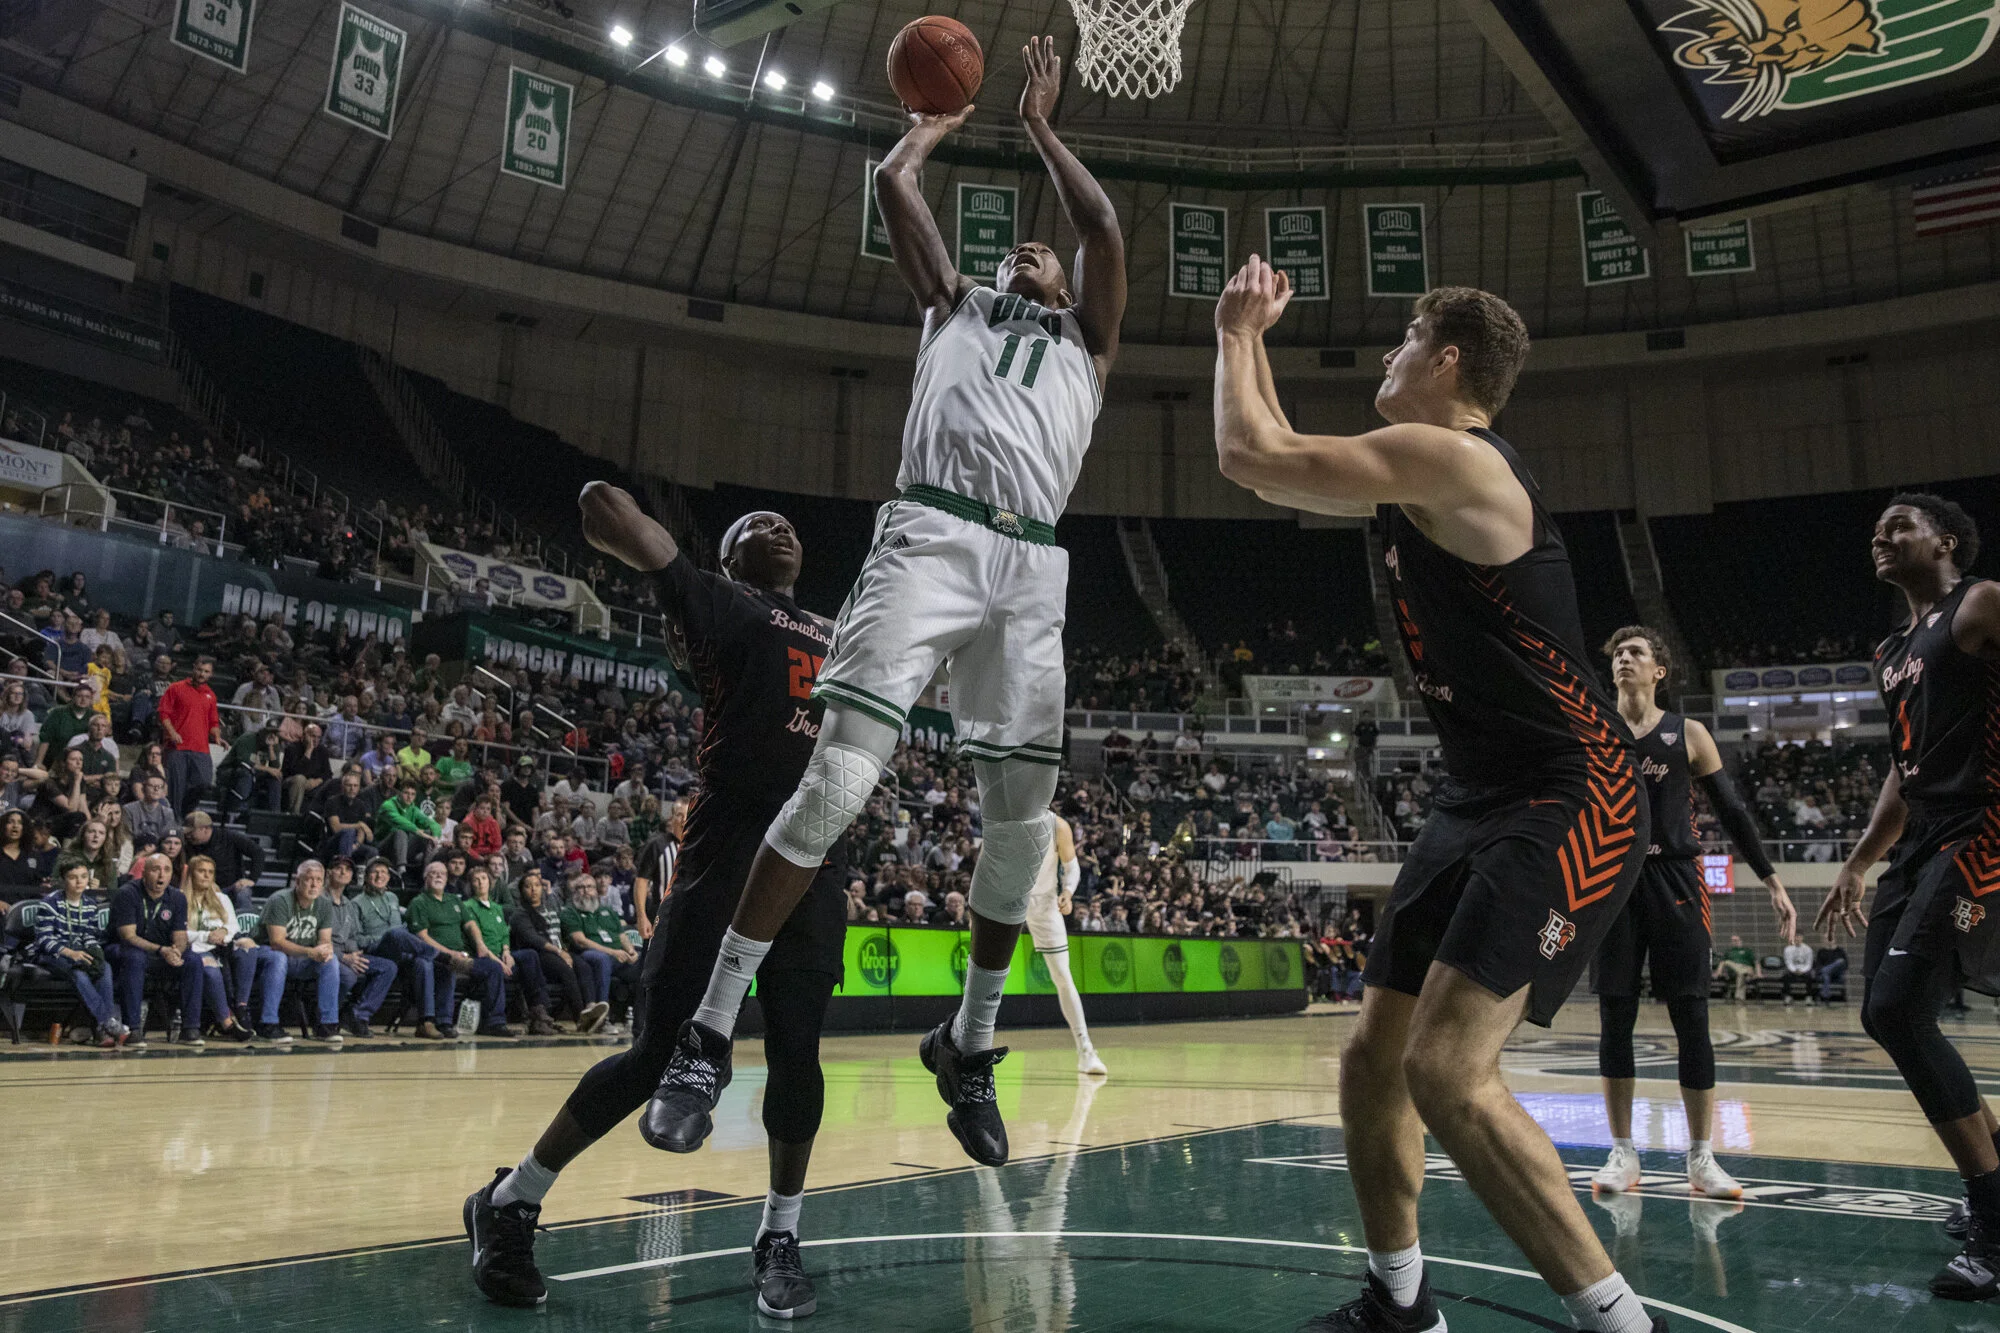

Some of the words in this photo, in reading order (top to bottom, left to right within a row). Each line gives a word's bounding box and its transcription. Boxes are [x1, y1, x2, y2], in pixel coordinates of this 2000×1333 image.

[204, 4, 227, 27] 34
[347, 11, 399, 45] JAMERSON
[353, 54, 381, 81] OHIO
[354, 73, 375, 97] 33
[528, 79, 555, 96] TRENT
[525, 114, 552, 136] OHIO
[528, 132, 547, 151] 20
[971, 192, 1005, 215] OHIO
[1183, 211, 1215, 234] OHIO
[1279, 214, 1313, 235] OHIO
[1378, 210, 1412, 231] OHIO
[979, 229, 996, 240] NIT
[1692, 241, 1716, 251] ELITE
[1719, 237, 1747, 249] EIGHT
[1176, 253, 1222, 265] TOURNAMENT
[1189, 247, 1209, 255] NCAA
[1373, 252, 1421, 260] TOURNAMENT
[1386, 245, 1407, 253] NCAA
[1592, 248, 1622, 261] SWEET
[1705, 253, 1737, 265] 1964
[1273, 256, 1321, 265] TOURNAMENT
[1601, 261, 1633, 276] 2012
[18, 299, 47, 316] FANS
[49, 308, 60, 320] IN
[63, 312, 84, 327] THE
[85, 320, 107, 334] MAC
[109, 328, 132, 341] LIVE
[134, 335, 161, 350] HERE
[993, 333, 1050, 390] 11
[221, 583, 299, 627] HOME
[305, 600, 338, 632] OF
[344, 608, 403, 646] OHIO
[770, 608, 834, 654] Bowling
[484, 637, 567, 678] BOBCAT
[1704, 867, 1728, 888] 45
[861, 943, 898, 982] Kroger
